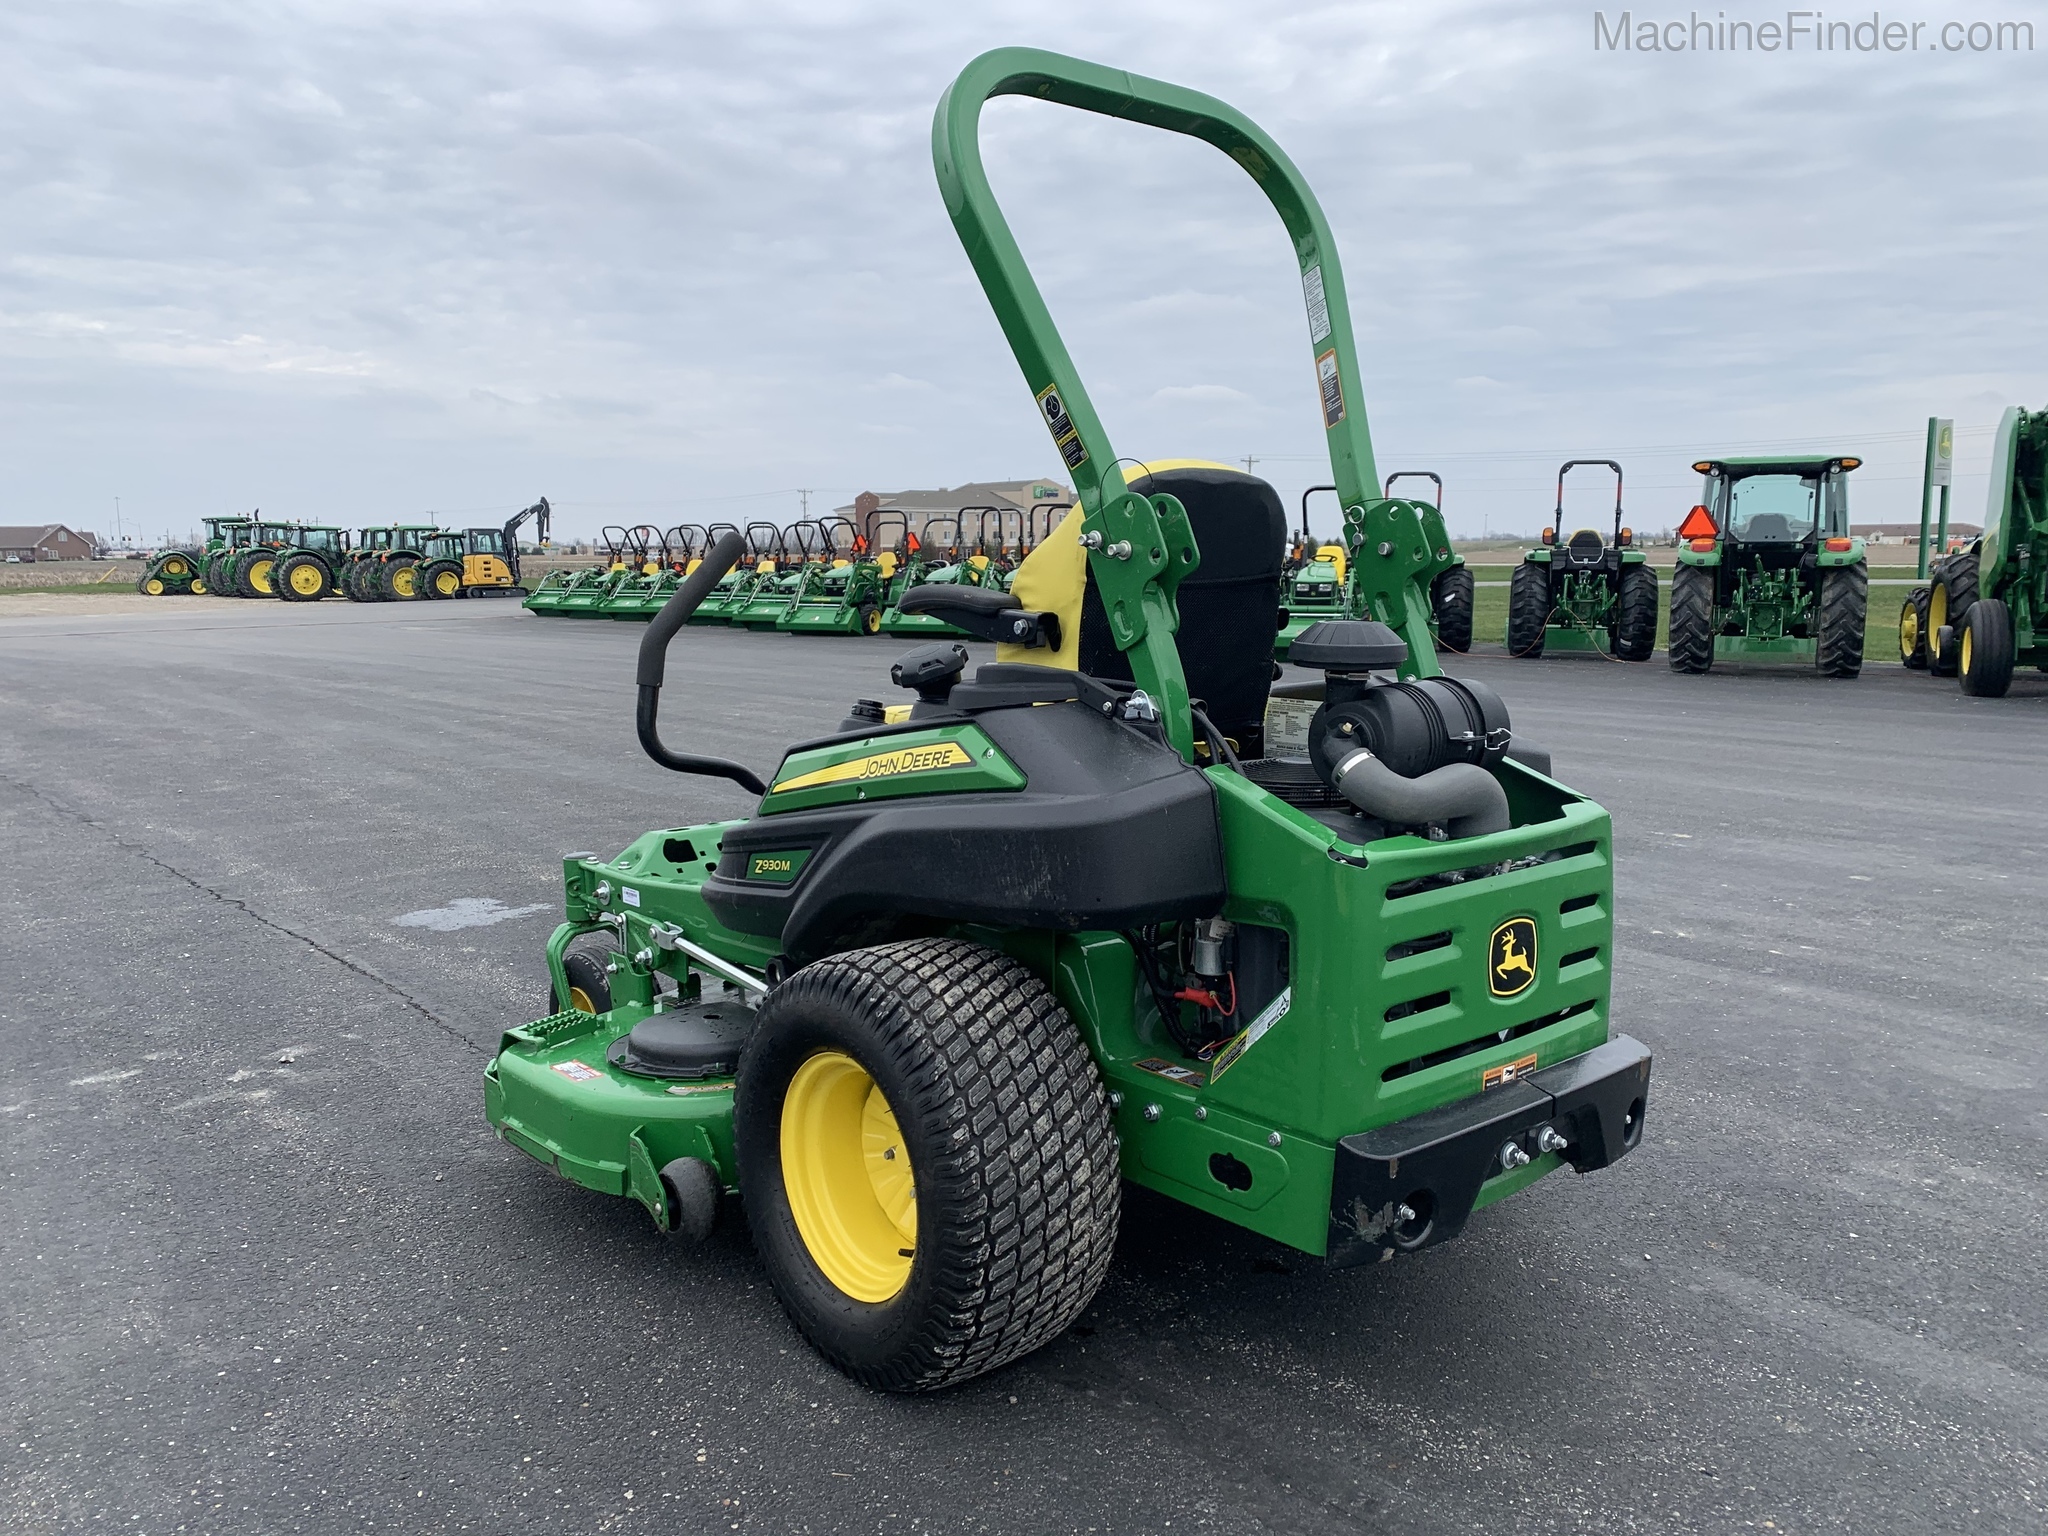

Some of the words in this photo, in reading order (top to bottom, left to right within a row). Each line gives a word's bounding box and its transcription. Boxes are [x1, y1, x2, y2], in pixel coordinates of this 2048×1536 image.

[859, 757, 900, 777] JOHN
[901, 749, 954, 770] DEERE
[754, 859, 791, 874] Z930M
